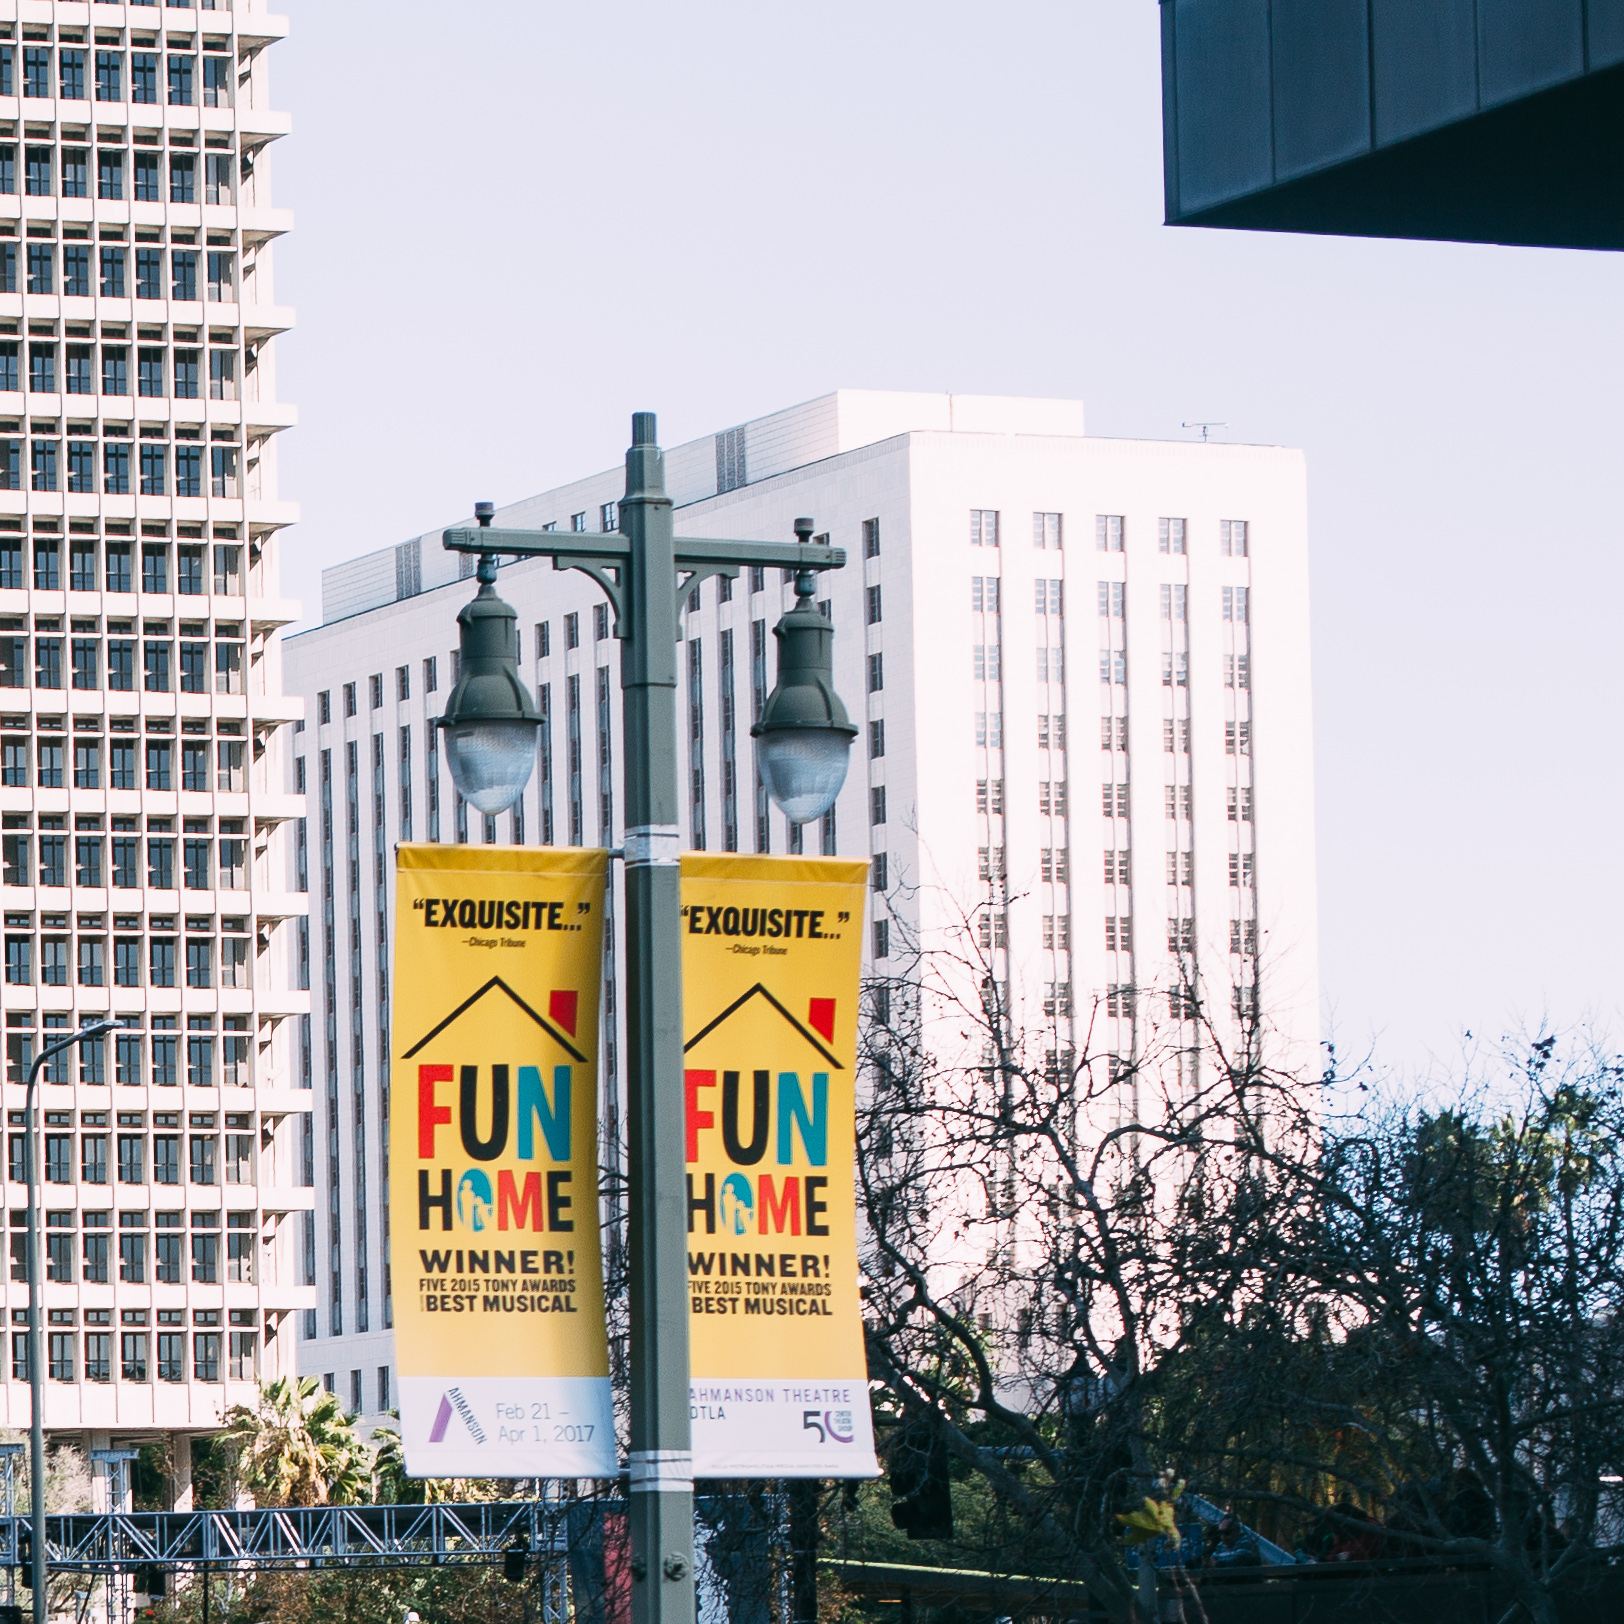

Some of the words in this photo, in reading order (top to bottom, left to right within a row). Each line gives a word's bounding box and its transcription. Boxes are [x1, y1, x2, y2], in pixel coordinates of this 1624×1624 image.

[500, 938, 525, 947] Tribune
[763, 945, 787, 954] Tribune
[418, 1064, 572, 1162] FUN
[684, 1068, 828, 1166] FUN
[418, 1169, 573, 1233] HOME
[687, 1173, 829, 1236] HOME
[419, 1250, 574, 1274] WINNER!
[688, 1252, 830, 1277] WINNER!
[419, 1279, 447, 1292] FIVE
[451, 1279, 480, 1292] 2015
[484, 1279, 517, 1292] TONY
[521, 1280, 575, 1292] AWARDS
[715, 1281, 741, 1294] 2015
[746, 1282, 775, 1295] TONY
[781, 1283, 831, 1295] AWARDS
[427, 1295, 477, 1312] BEST
[483, 1295, 577, 1312] MUSICAL
[692, 1297, 740, 1314] BEST
[745, 1298, 832, 1315] MUSICAL
[783, 1389, 851, 1403] THEATRE
[448, 1387, 487, 1445] AHMANSON
[496, 1403, 525, 1419] Feb
[532, 1403, 550, 1419] 21
[499, 1426, 525, 1444] Apr
[554, 1425, 595, 1442] 2017
